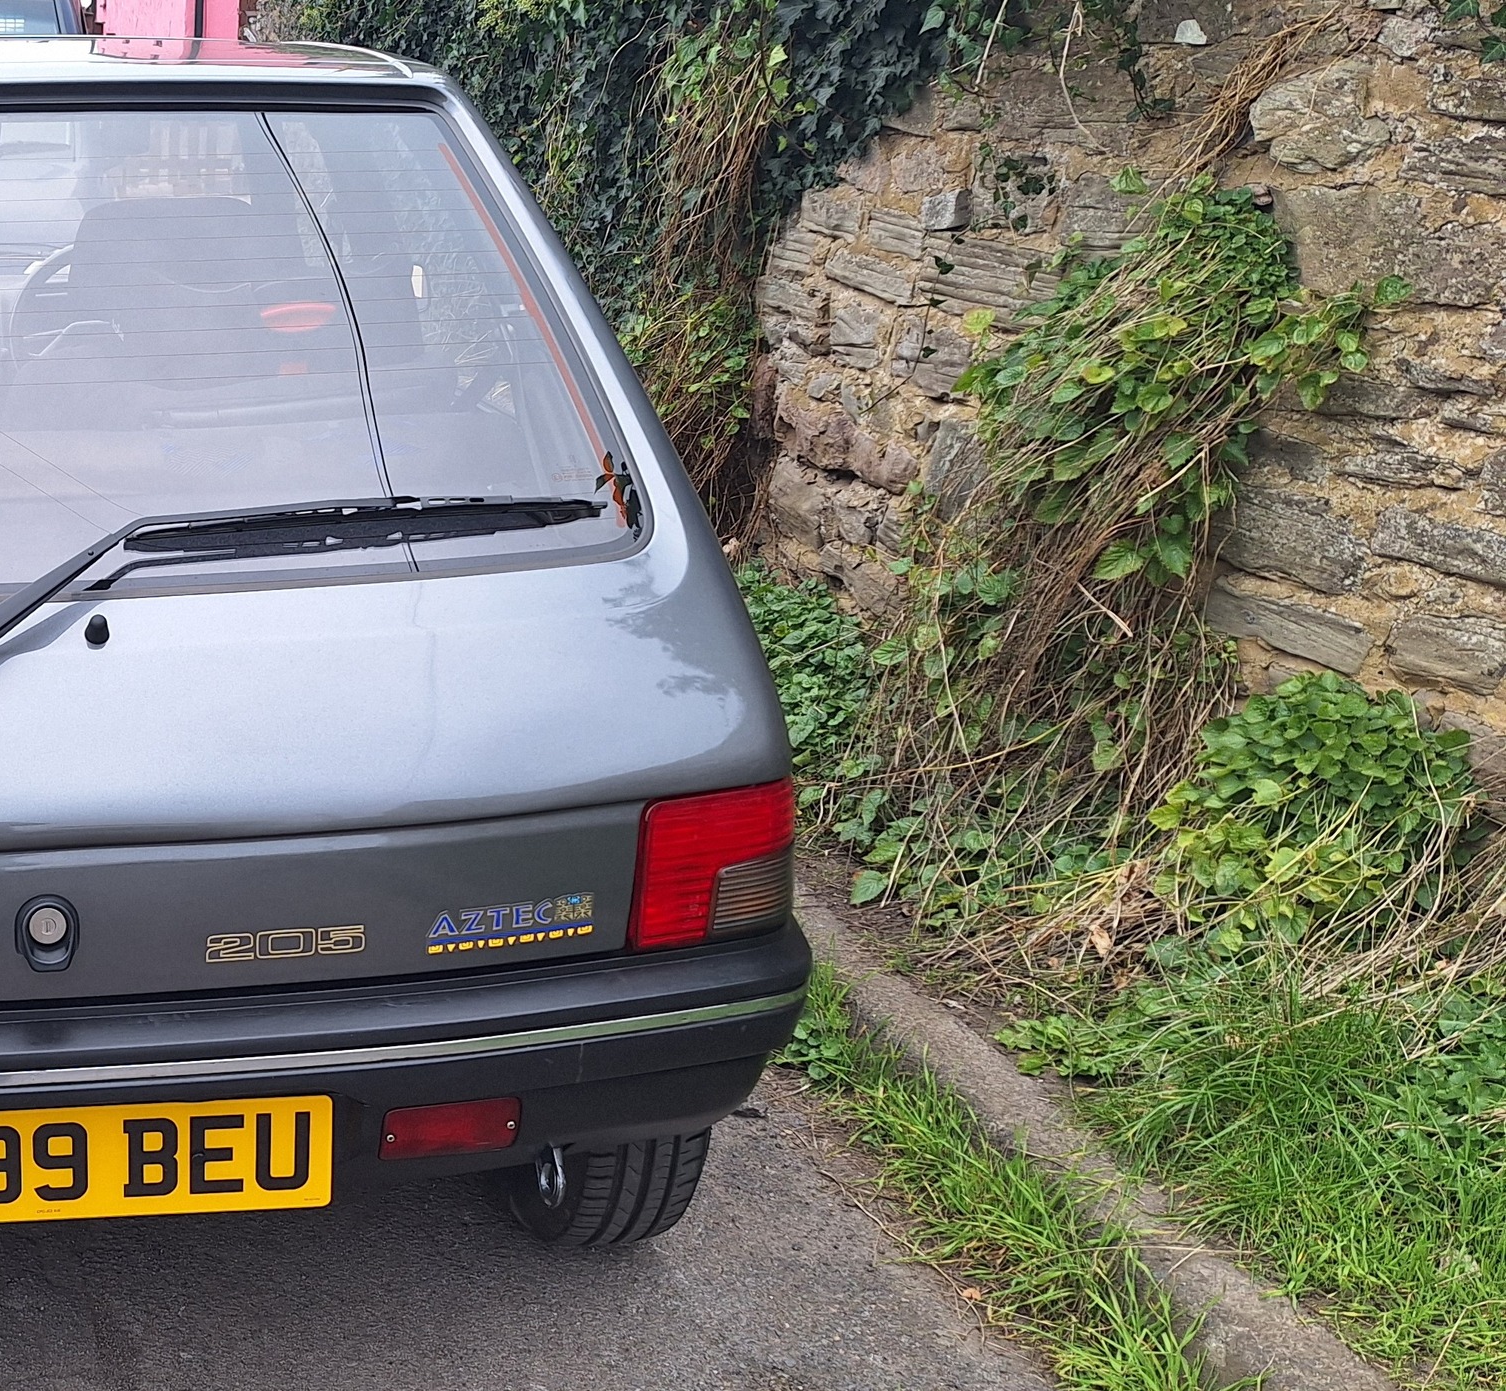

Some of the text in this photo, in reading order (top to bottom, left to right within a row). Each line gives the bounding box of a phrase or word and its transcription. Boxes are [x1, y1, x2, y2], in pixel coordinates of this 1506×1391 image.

[426, 899, 553, 939] AZTEC
[204, 924, 366, 963] 205
[123, 1111, 312, 1199] BEU
